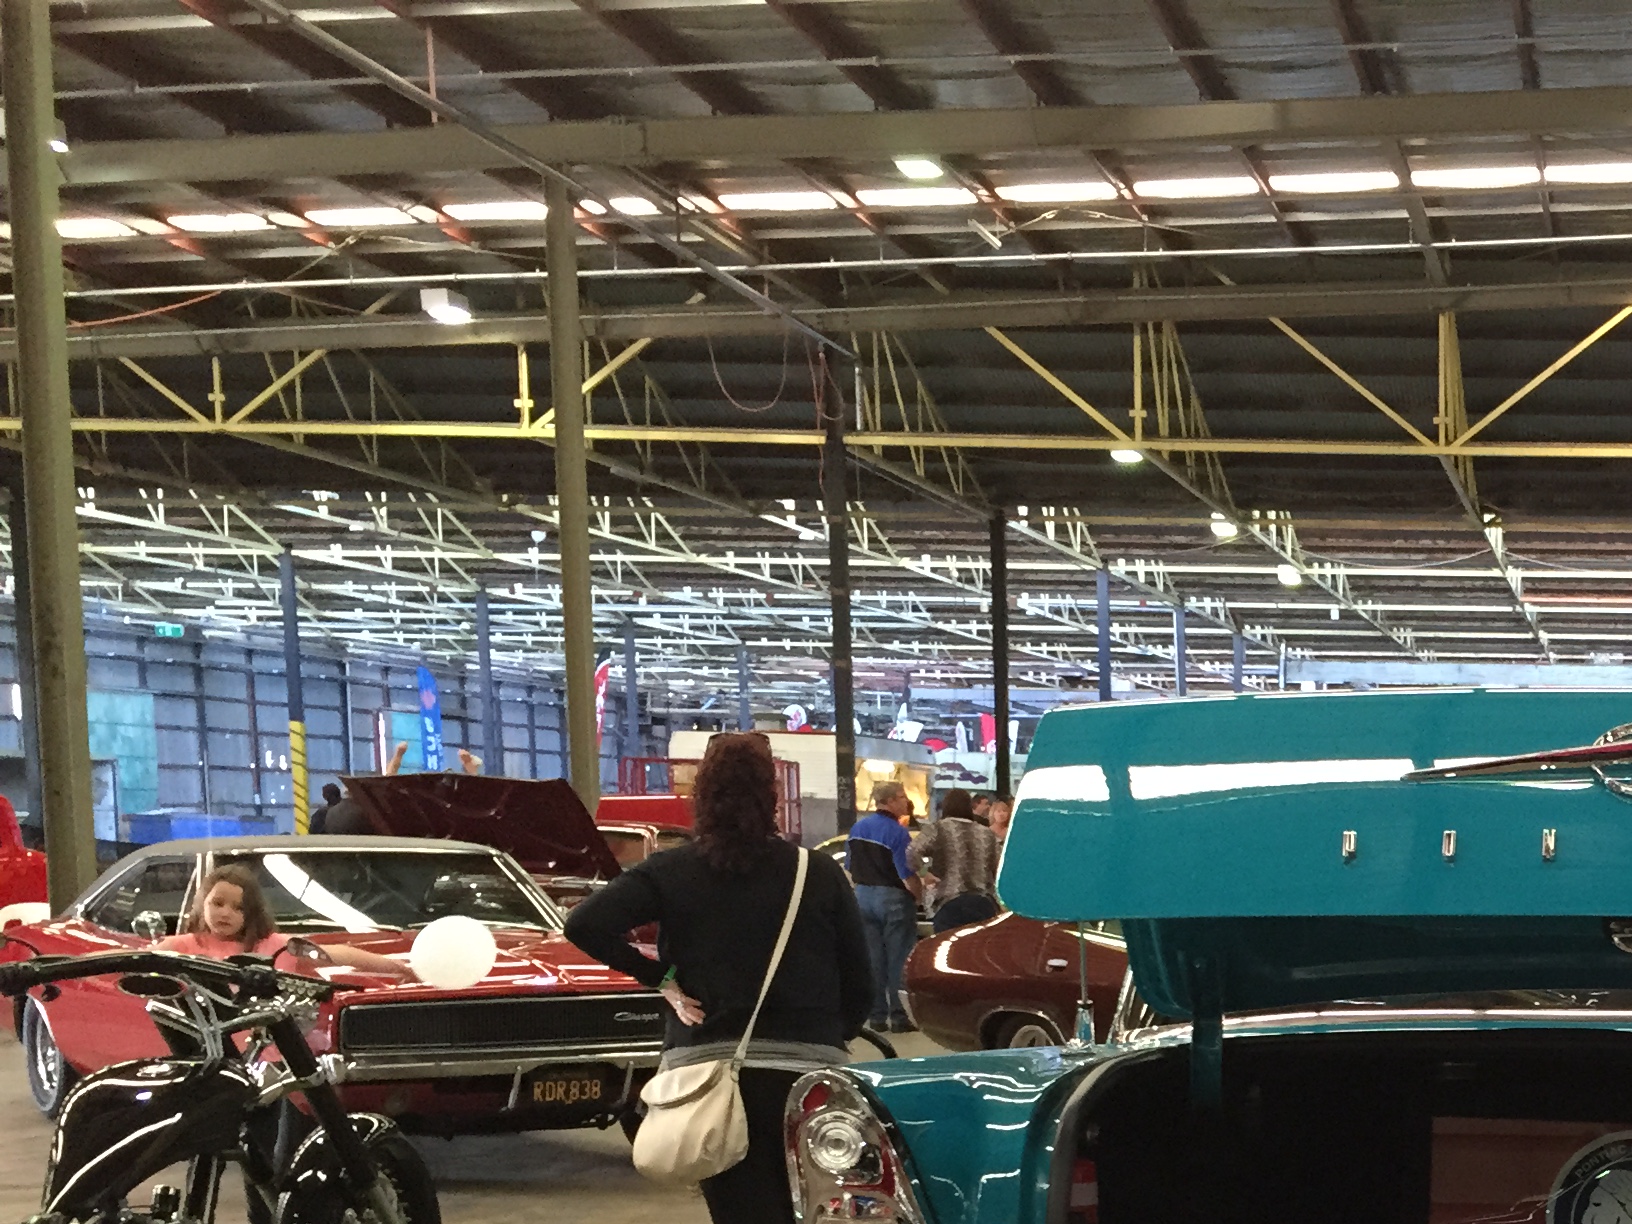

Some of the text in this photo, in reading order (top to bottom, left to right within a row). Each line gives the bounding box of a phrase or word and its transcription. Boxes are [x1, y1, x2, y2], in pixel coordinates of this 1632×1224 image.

[533, 1079, 602, 1101] RDR 838
[1574, 1144, 1627, 1179] PONTIAC
